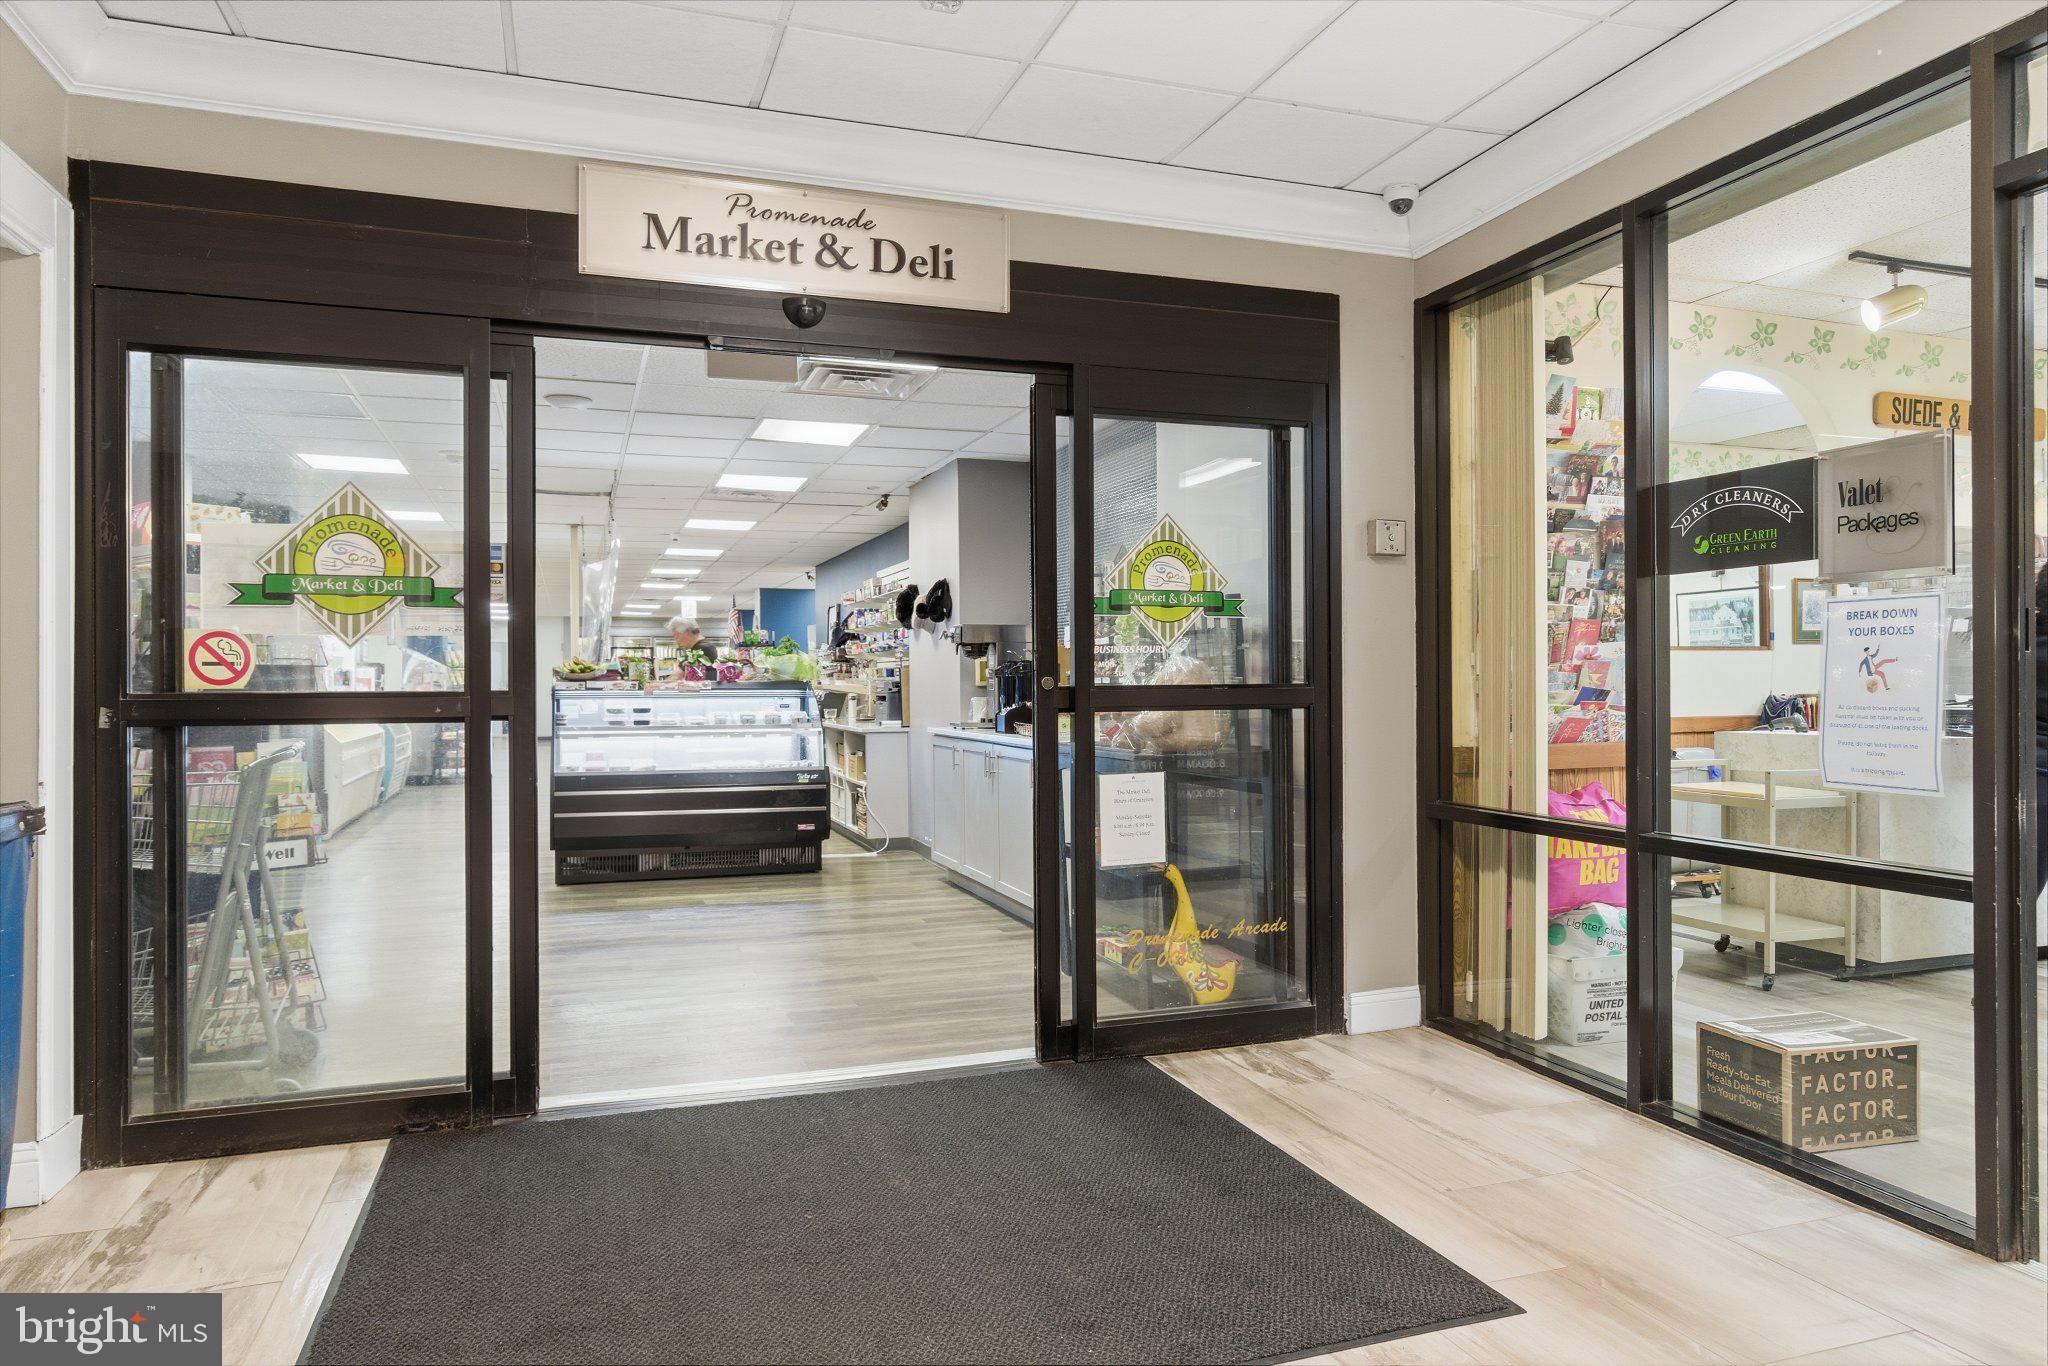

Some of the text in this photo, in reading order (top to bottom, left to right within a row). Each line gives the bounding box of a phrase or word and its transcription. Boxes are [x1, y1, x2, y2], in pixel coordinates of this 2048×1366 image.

[725, 192, 877, 231] Promenade
[642, 212, 956, 281] Market & Deli
[1892, 396, 1942, 428] SUEDE
[1949, 403, 1960, 429] &
[1838, 477, 1884, 508] Valet
[1681, 490, 1791, 526] DRY CLEANERS
[1838, 511, 1919, 534] Packages
[298, 520, 397, 558] Promenade
[1710, 541, 1777, 554] CLEANING
[1133, 545, 1199, 575] Promenade
[292, 577, 404, 593] Market & Deli
[1129, 592, 1204, 604] Market & Deli
[1846, 608, 1918, 620] BREAK DOWN
[1848, 625, 1915, 636] YOUR BOXES
[1094, 645, 1134, 654] BUSINESS
[1579, 857, 1620, 886] BAG
[1228, 916, 1288, 939] Arcade
[1566, 918, 1603, 932] Lighter
[1589, 998, 1624, 1010] UNITED
[1584, 1011, 1622, 1023] POSTAL
[1706, 1045, 1731, 1062] Fresh
[1706, 1057, 1771, 1088] Ready-to-Eat
[1706, 1069, 1779, 1104] Meals Delivered
[1707, 1083, 1762, 1111] to Your Door
